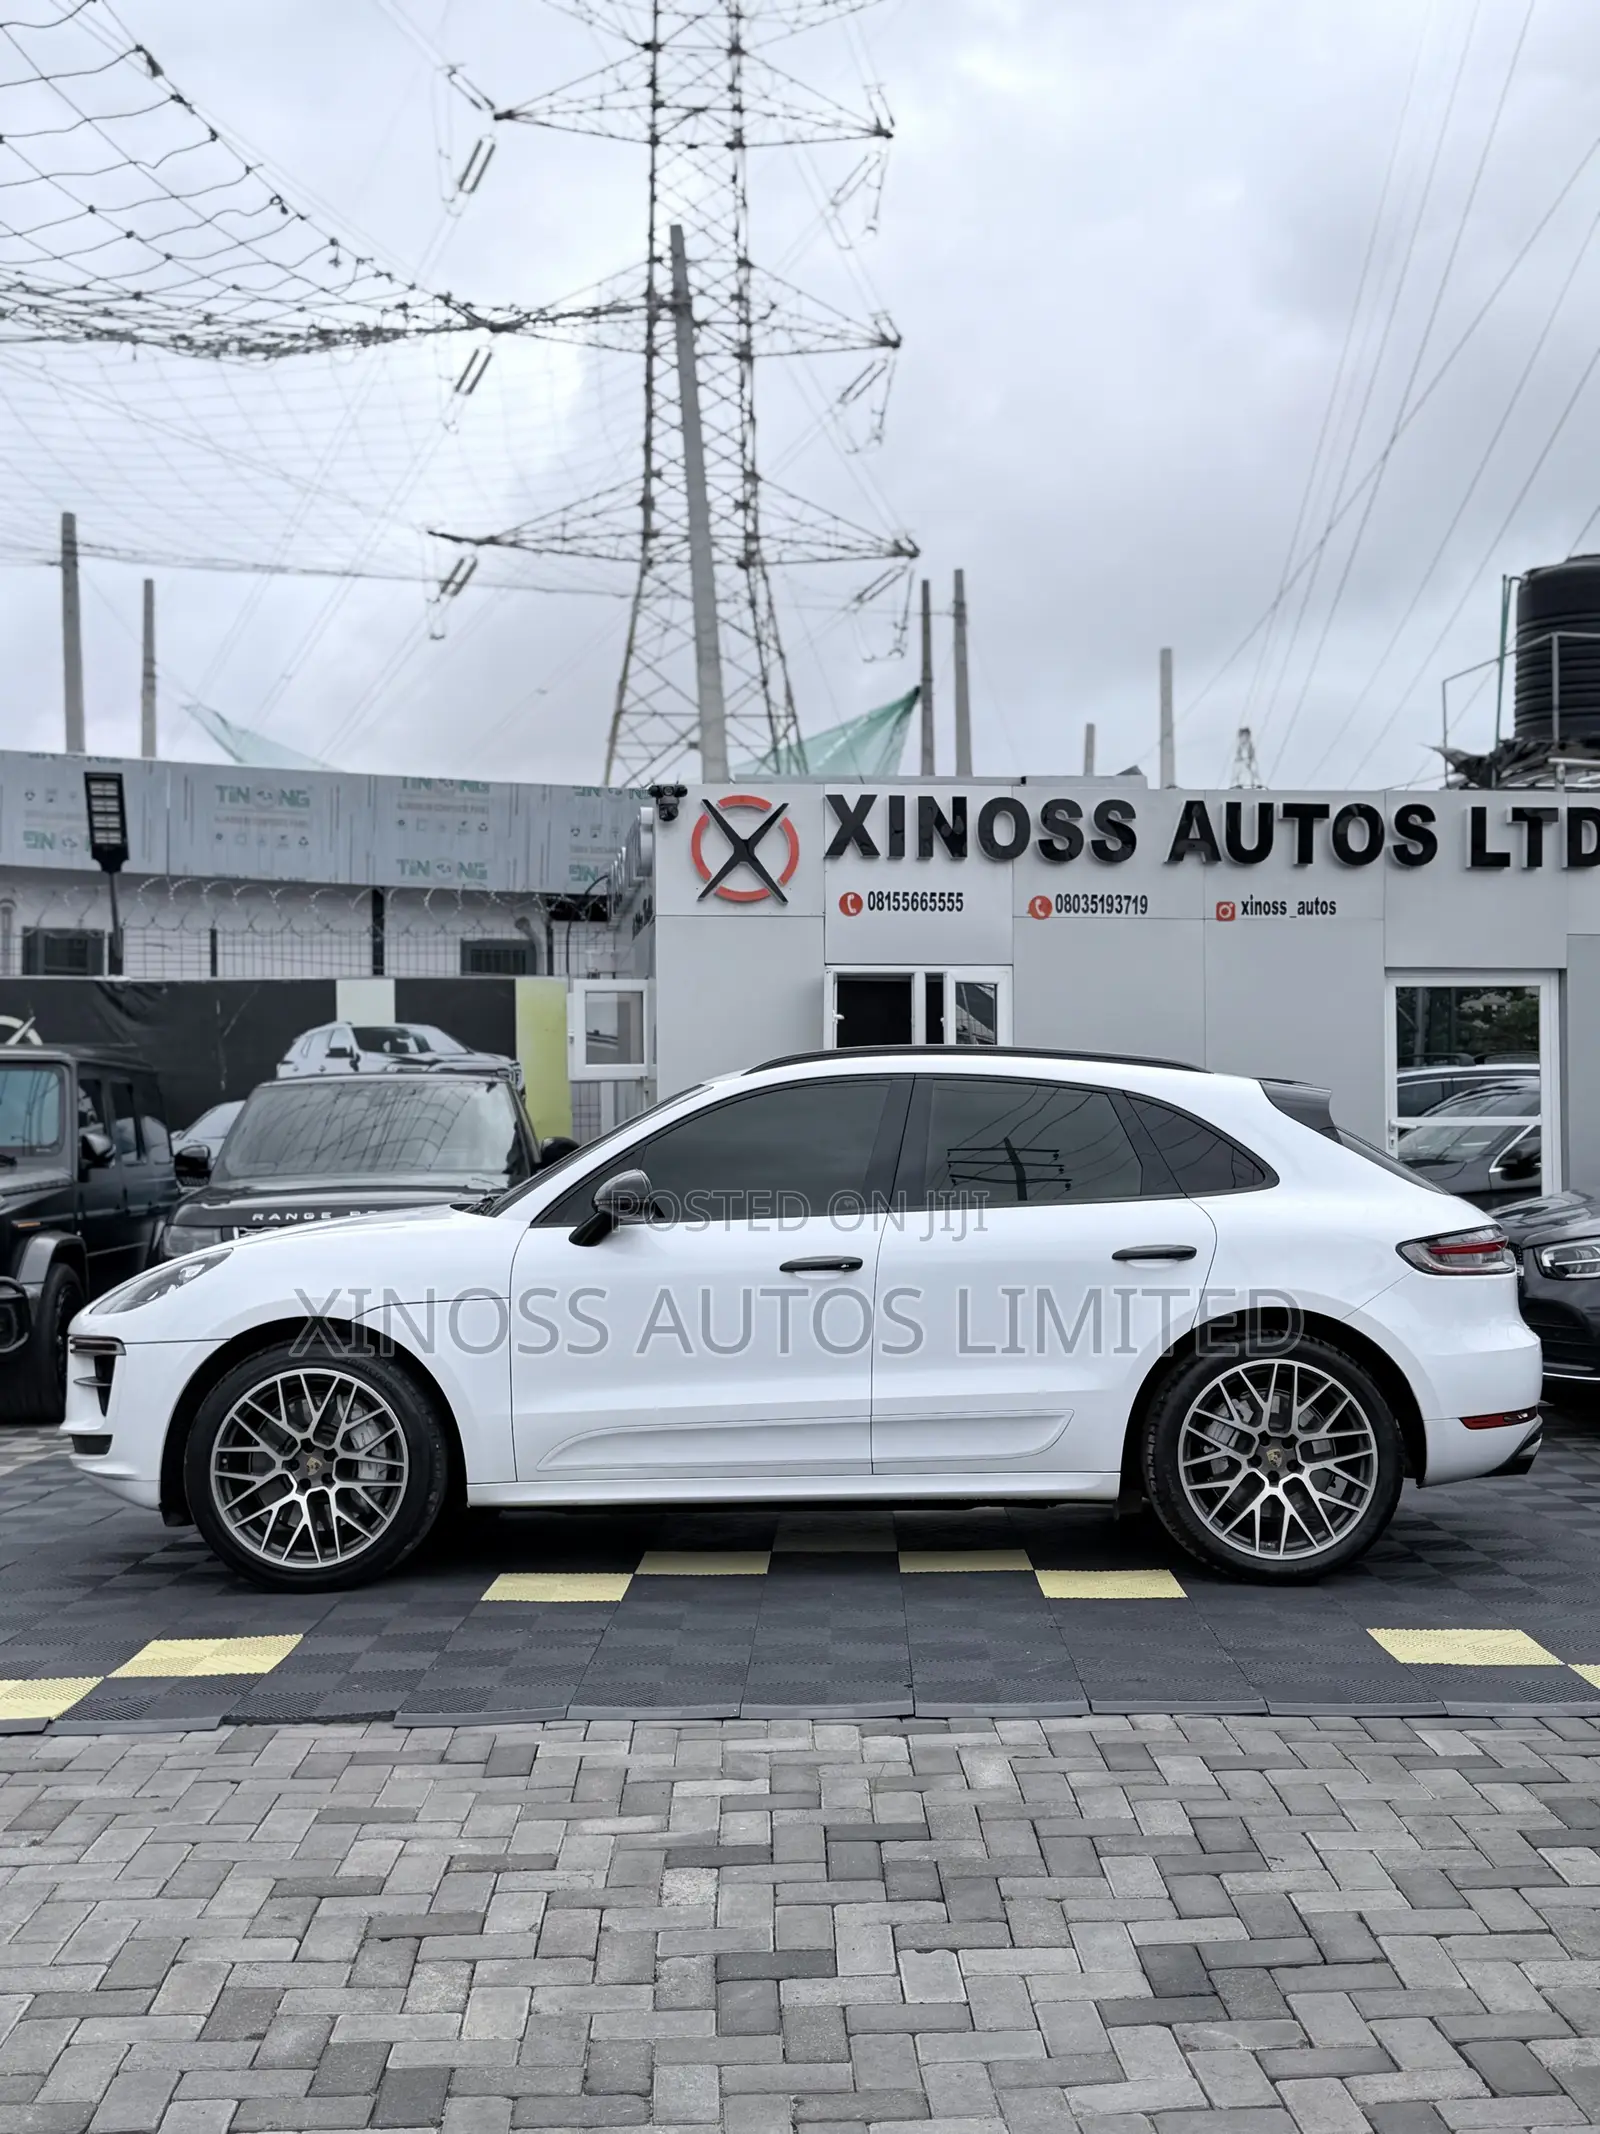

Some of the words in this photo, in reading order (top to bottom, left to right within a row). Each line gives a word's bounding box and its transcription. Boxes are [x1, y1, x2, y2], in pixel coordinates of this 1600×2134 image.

[824, 794, 1137, 863] XINOSS
[1164, 800, 1438, 868] AUTOS
[1467, 806, 1600, 869] LTD
[867, 891, 964, 912] 08155665555
[1055, 893, 1148, 915] 08035193719
[1241, 894, 1336, 918] xinoss_autos
[252, 1211, 332, 1222] RANGE
